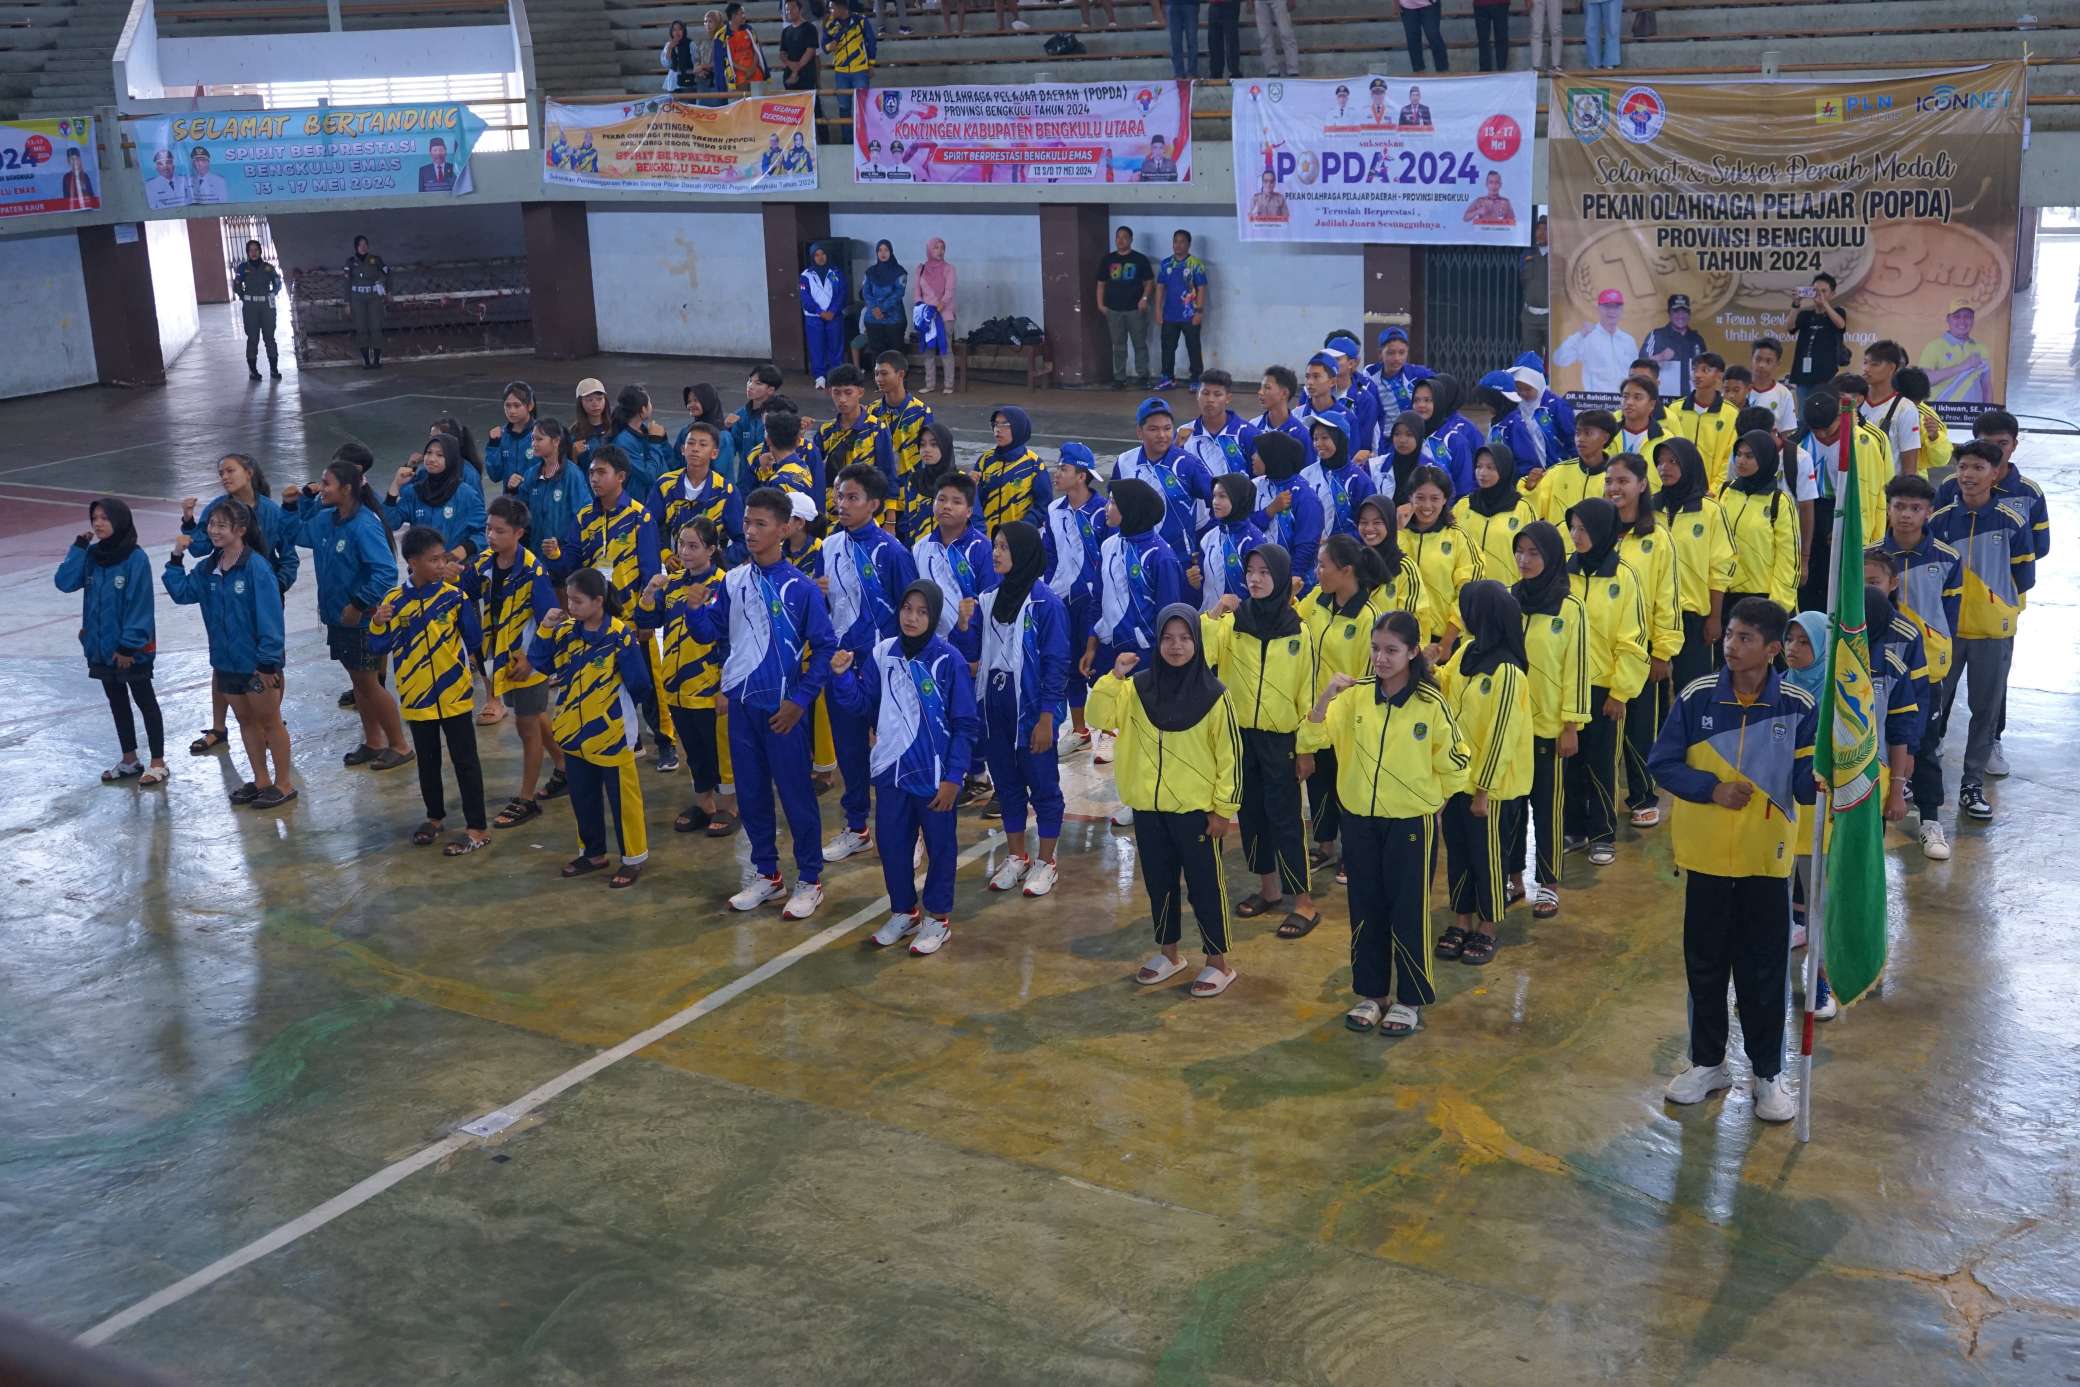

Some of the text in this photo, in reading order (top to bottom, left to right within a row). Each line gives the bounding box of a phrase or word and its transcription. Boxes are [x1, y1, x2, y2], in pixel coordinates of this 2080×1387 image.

[911, 84, 1129, 103] PEKAN OLAHRAGA PELAJAR DAERAH (POPDA)
[1846, 95, 1893, 113] PLN
[1915, 89, 2012, 113] ICONNET
[944, 102, 1091, 118] PROVINSI BENGKULU TAHUN 2024
[172, 114, 290, 142] SELAMAT
[895, 118, 1145, 139] KONTINGEN KABUPATEN BENGKULU UTARA
[225, 140, 417, 161] SPIRIT BERPRESTASI
[943, 150, 1093, 162] SPIRIT BERPRESTASI BENGKULU EMAS
[1490, 140, 1506, 151] Mei
[351, 158, 401, 172] EMAS
[1399, 151, 1479, 185] 2024
[1595, 151, 1957, 185] Selamat & Sukses Peraih Medali
[313, 177, 345, 192] MEI
[351, 174, 396, 191] 2024
[1371, 192, 1397, 201] DAERAH
[1582, 189, 1952, 224] PEKAN OLAHRAGA PELAJAR (POPDA)
[1656, 226, 1866, 249] PROVINSI BENGKULU
[1695, 249, 1822, 272] TAHUN 2024
